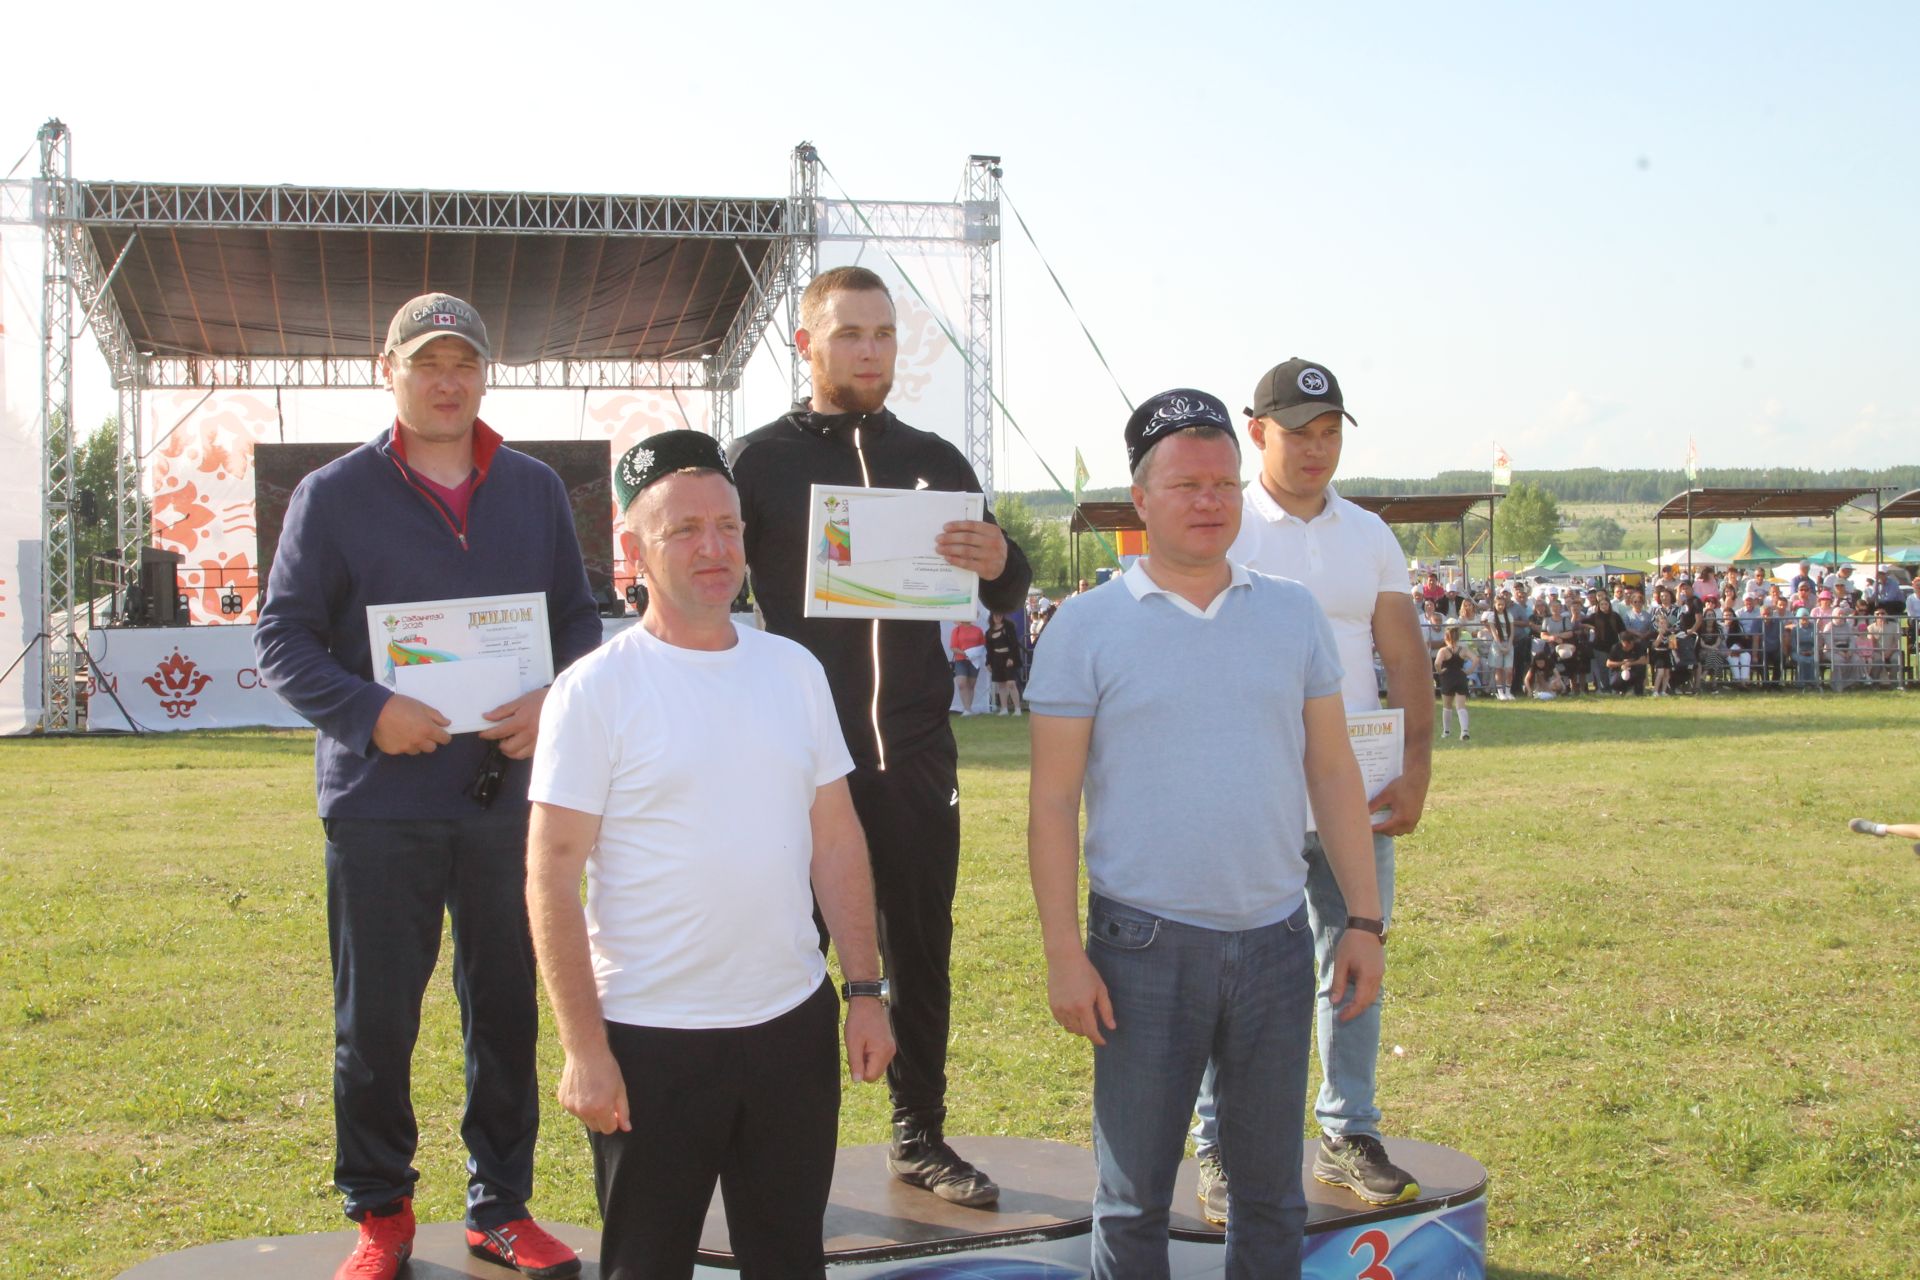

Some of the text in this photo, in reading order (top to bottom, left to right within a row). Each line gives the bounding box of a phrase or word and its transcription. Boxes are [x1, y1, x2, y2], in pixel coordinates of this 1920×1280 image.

[412, 302, 473, 322] CANADA
[468, 607, 534, 630] ДИПЛОМ
[1347, 722, 1393, 738] ИПЛОМ
[1348, 1228, 1395, 1280] 3
